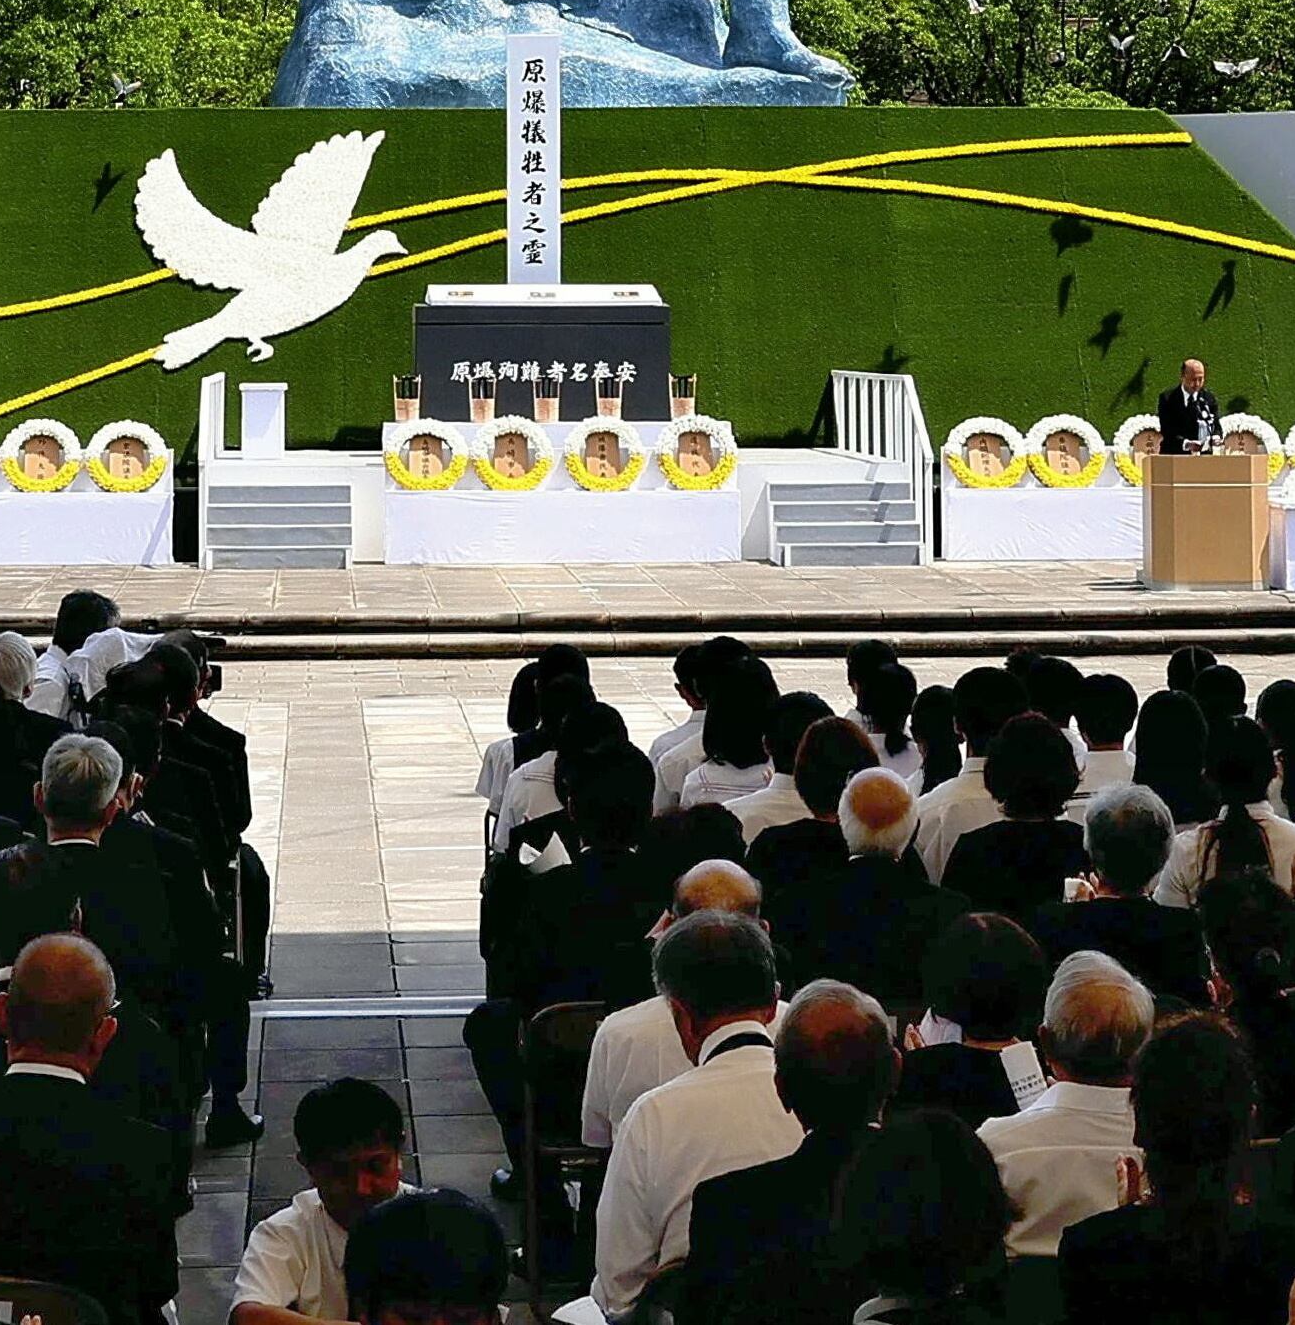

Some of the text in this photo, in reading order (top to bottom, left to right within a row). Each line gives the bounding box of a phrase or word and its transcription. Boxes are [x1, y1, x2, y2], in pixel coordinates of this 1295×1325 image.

[521, 59, 546, 264] 原爆犠牲者之霊
